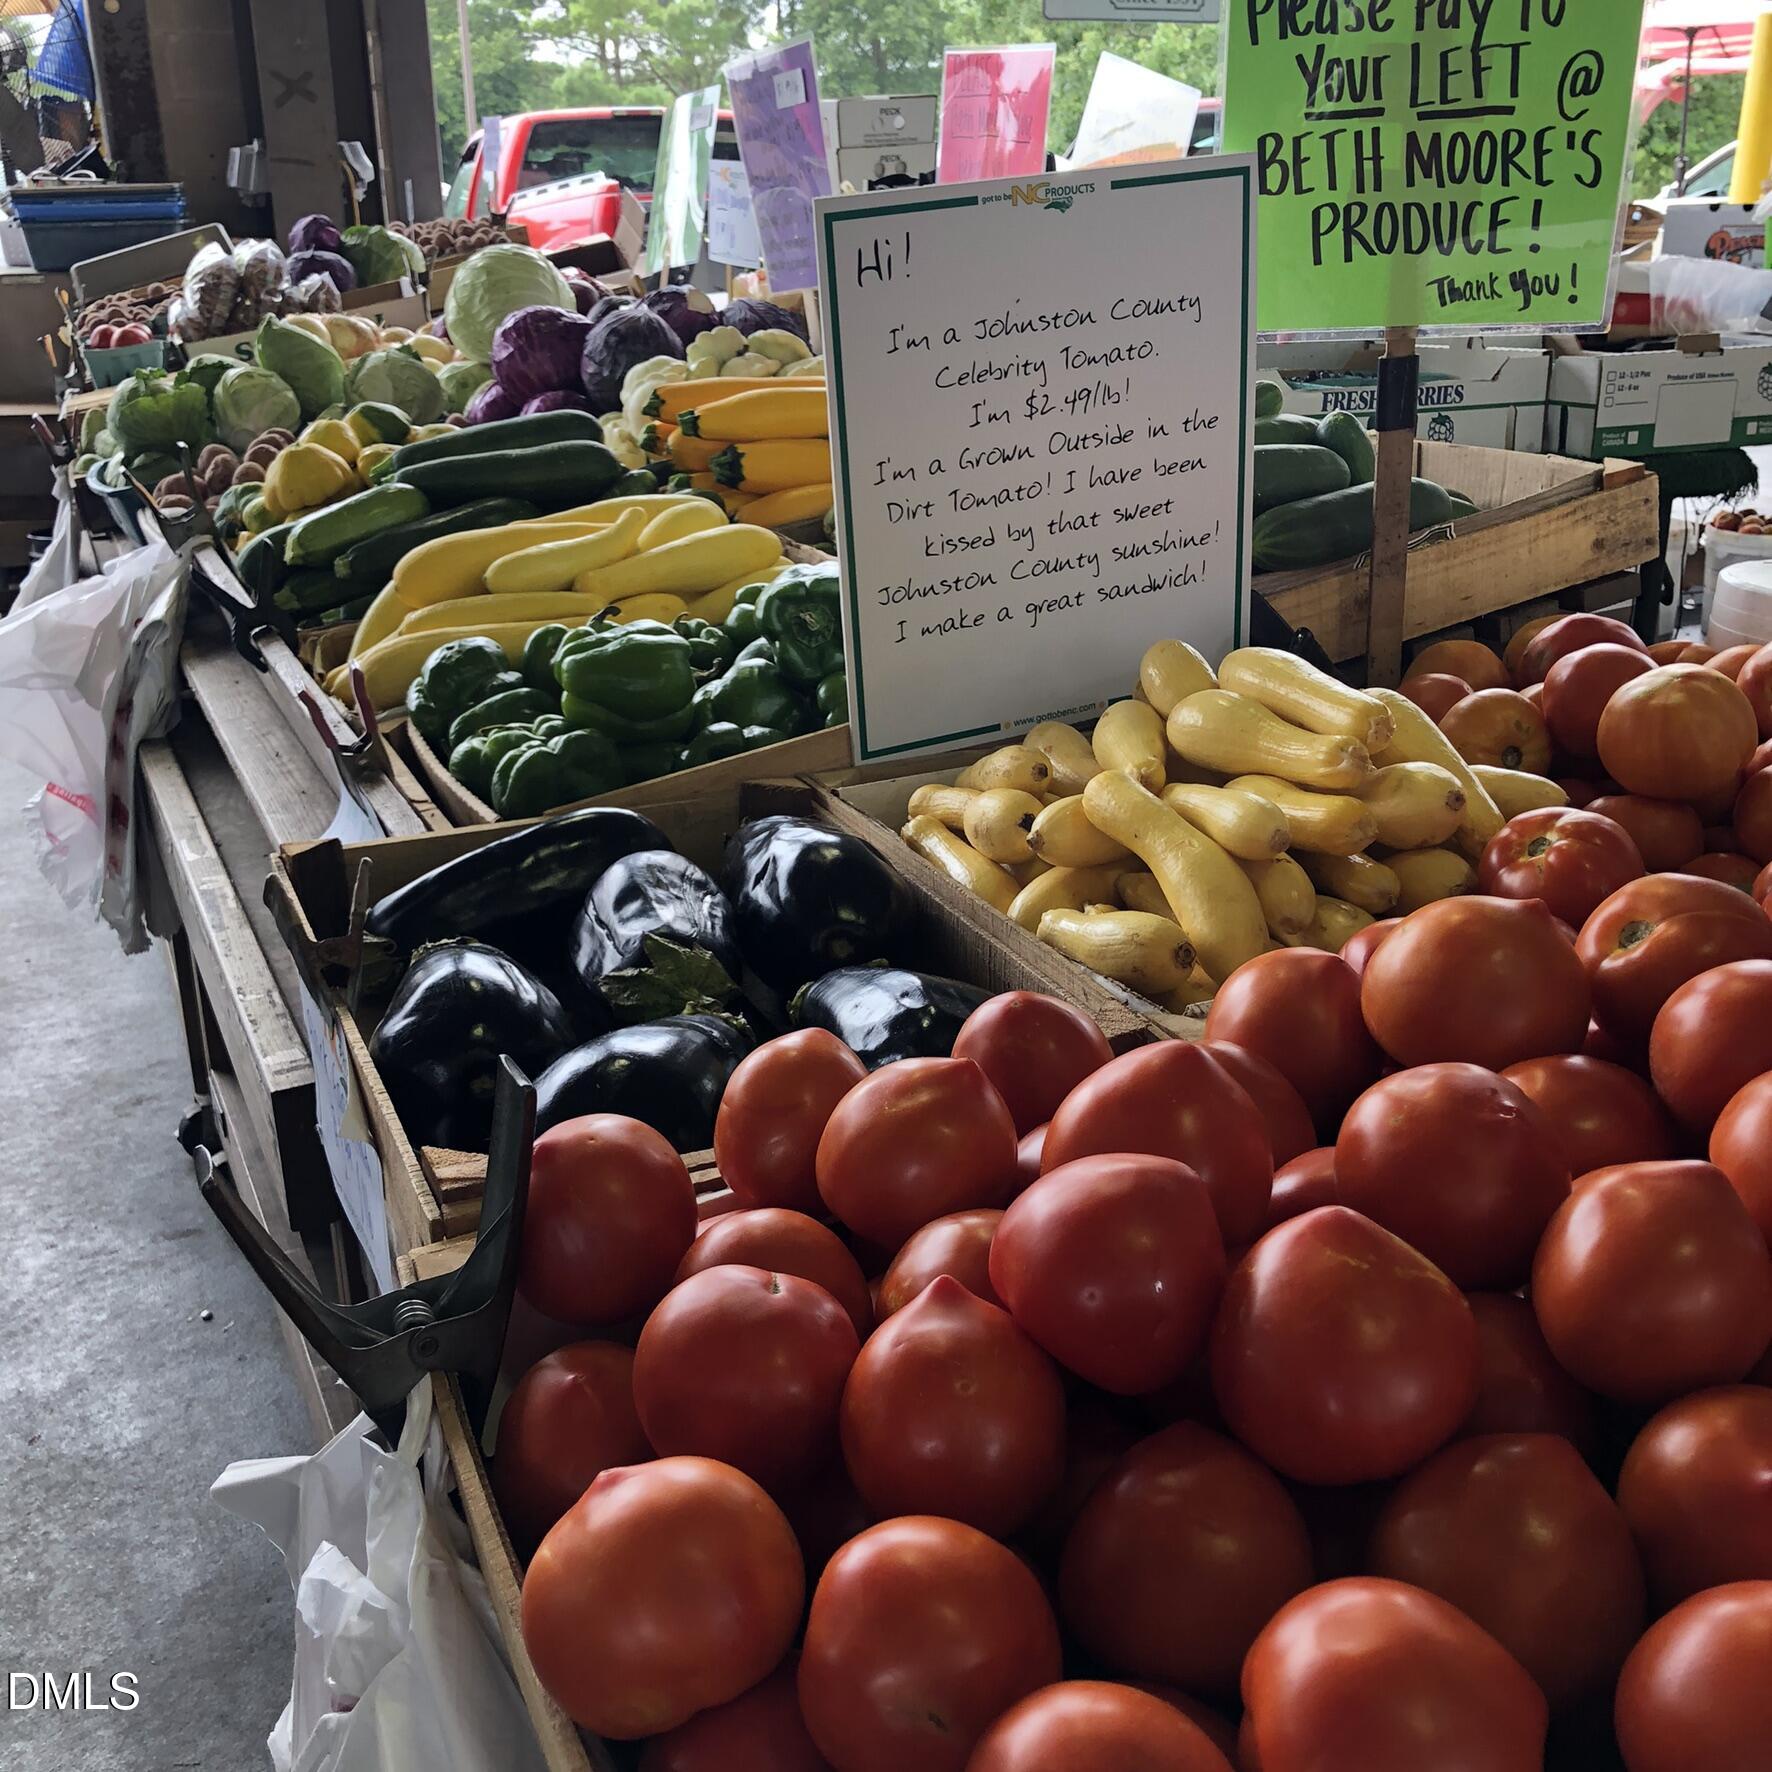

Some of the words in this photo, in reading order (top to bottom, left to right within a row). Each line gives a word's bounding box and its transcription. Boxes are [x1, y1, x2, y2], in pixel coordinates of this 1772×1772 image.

[1415, 0, 1492, 53] Pay
[1409, 41, 1532, 109] LEFT
[1557, 49, 1605, 122] @
[1256, 126, 1385, 196] BETH
[1405, 126, 1603, 190] MOORE'S
[981, 195, 994, 205] got
[995, 193, 1002, 202] to
[1002, 191, 1013, 201] be
[1011, 181, 1052, 207] NC
[1045, 182, 1096, 198] PRODUCTS
[857, 231, 912, 287] Hi!
[1426, 271, 1503, 308] Thank
[887, 324, 931, 354] I'm
[943, 328, 961, 345] a
[974, 310, 1098, 340] Johnston
[1110, 294, 1202, 323] County
[935, 354, 1048, 389] Celebrity
[1060, 341, 1159, 370] Tomato.
[969, 399, 1010, 428] I'm
[1024, 378, 1130, 421] $2.49/lb!
[1417, 384, 1465, 406] RRIES
[873, 457, 916, 486] I'm
[928, 459, 946, 475] a
[959, 443, 1035, 470] Grown
[1048, 424, 1135, 454] Outside
[1147, 417, 1170, 439] in
[1182, 408, 1220, 433] the
[887, 499, 936, 524] Dirt
[948, 473, 1052, 513] Tomato!
[1064, 470, 1077, 494] I
[1089, 464, 1143, 488] have
[1153, 456, 1208, 475] been
[1008, 524, 1036, 551] by
[1047, 510, 1101, 536] that
[1113, 498, 1176, 523] sweet
[877, 570, 998, 607] Johnston
[1010, 553, 1101, 580] County
[1111, 520, 1221, 562] sunshine!
[894, 619, 909, 643] I
[920, 608, 985, 638] make
[997, 606, 1014, 622] a
[1025, 590, 1086, 629] great
[1096, 559, 1207, 602] sandwich!
